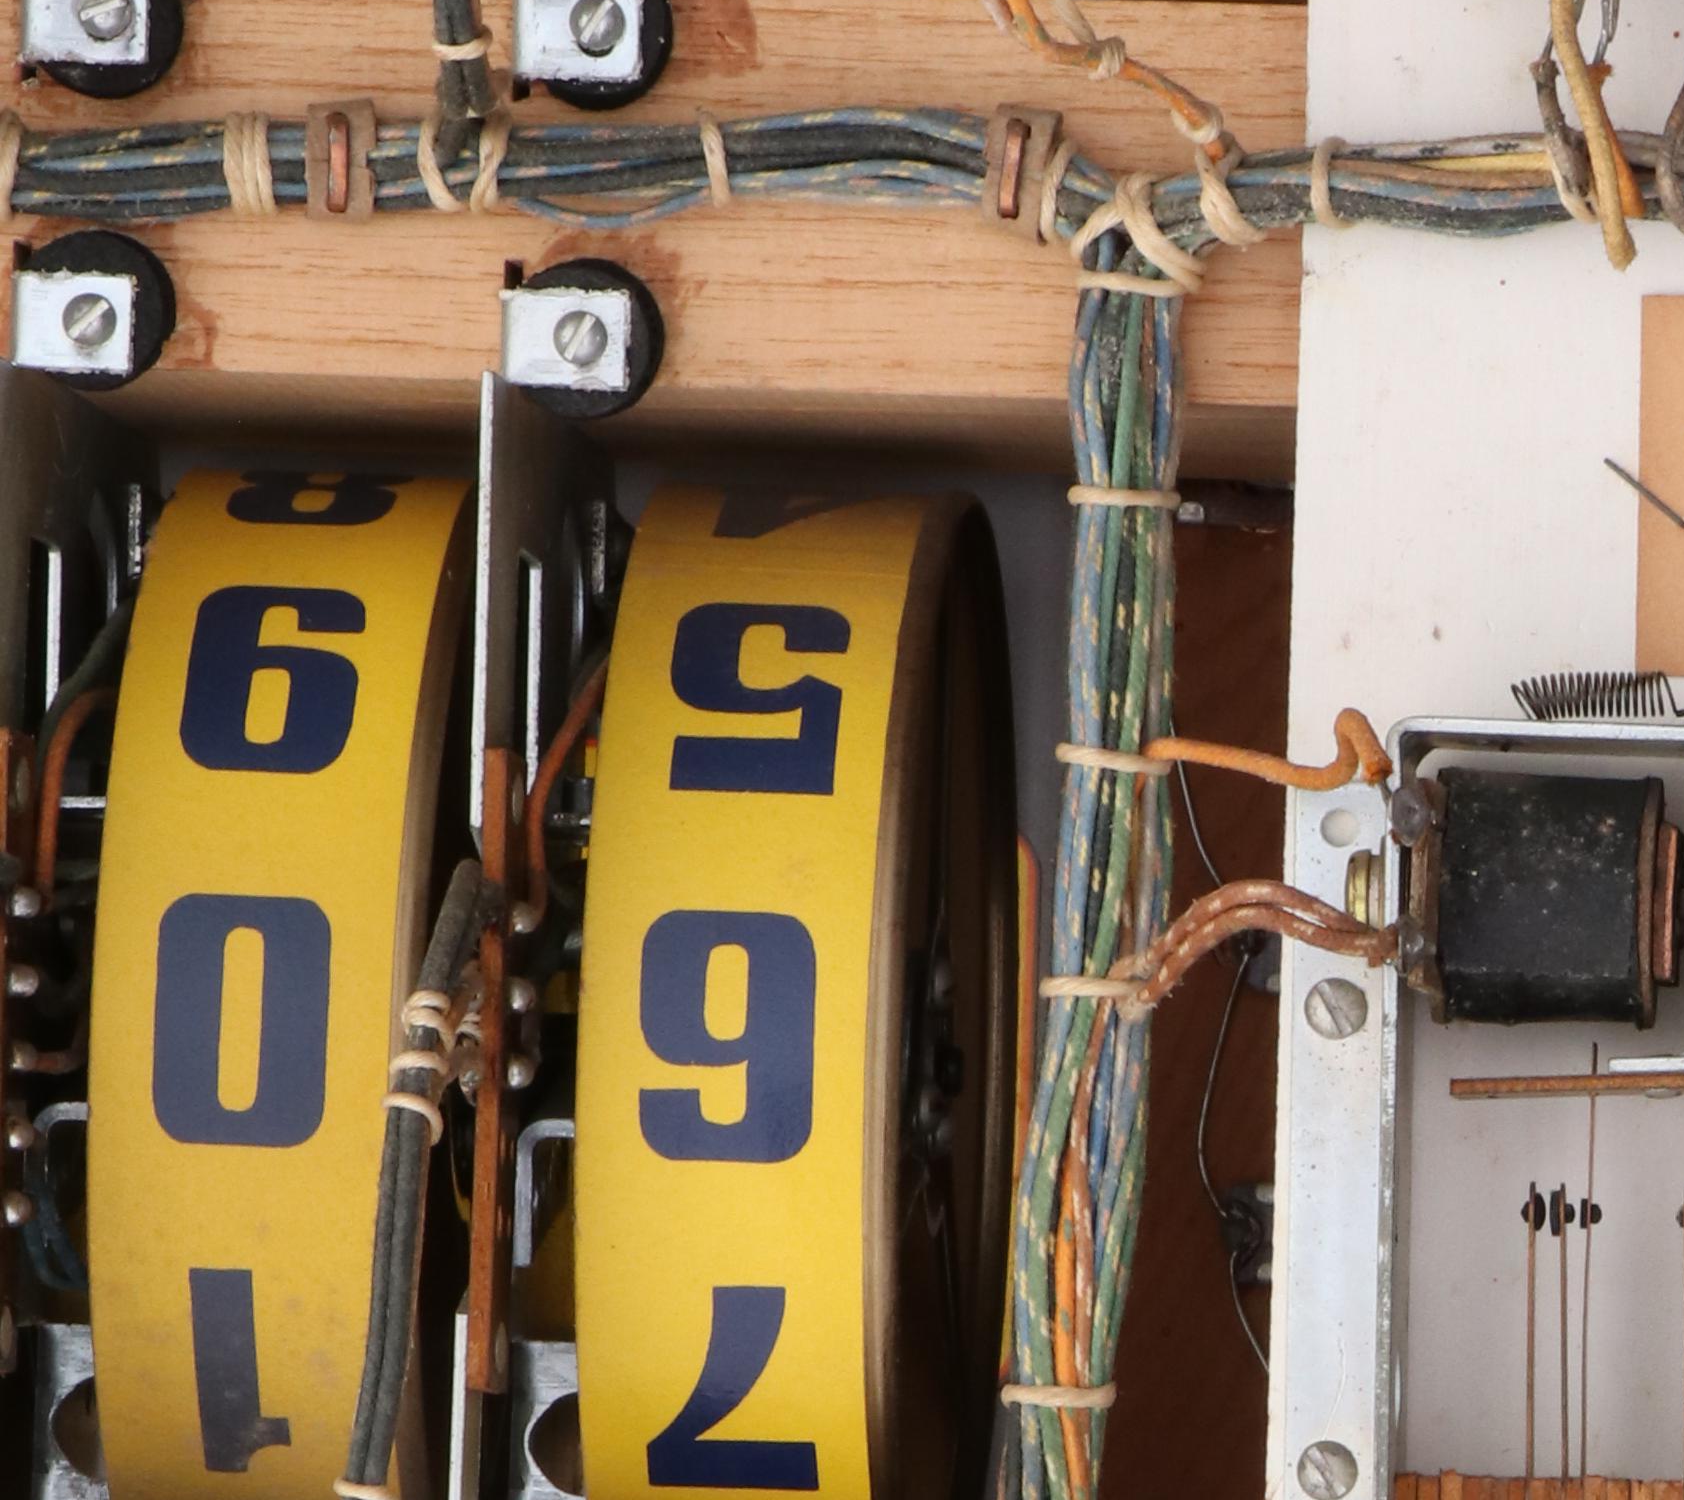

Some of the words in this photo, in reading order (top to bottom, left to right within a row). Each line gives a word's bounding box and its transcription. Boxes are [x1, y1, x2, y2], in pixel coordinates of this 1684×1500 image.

[669, 603, 851, 795] 5
[152, 893, 332, 1147] 0
[647, 1285, 820, 1491] 7
